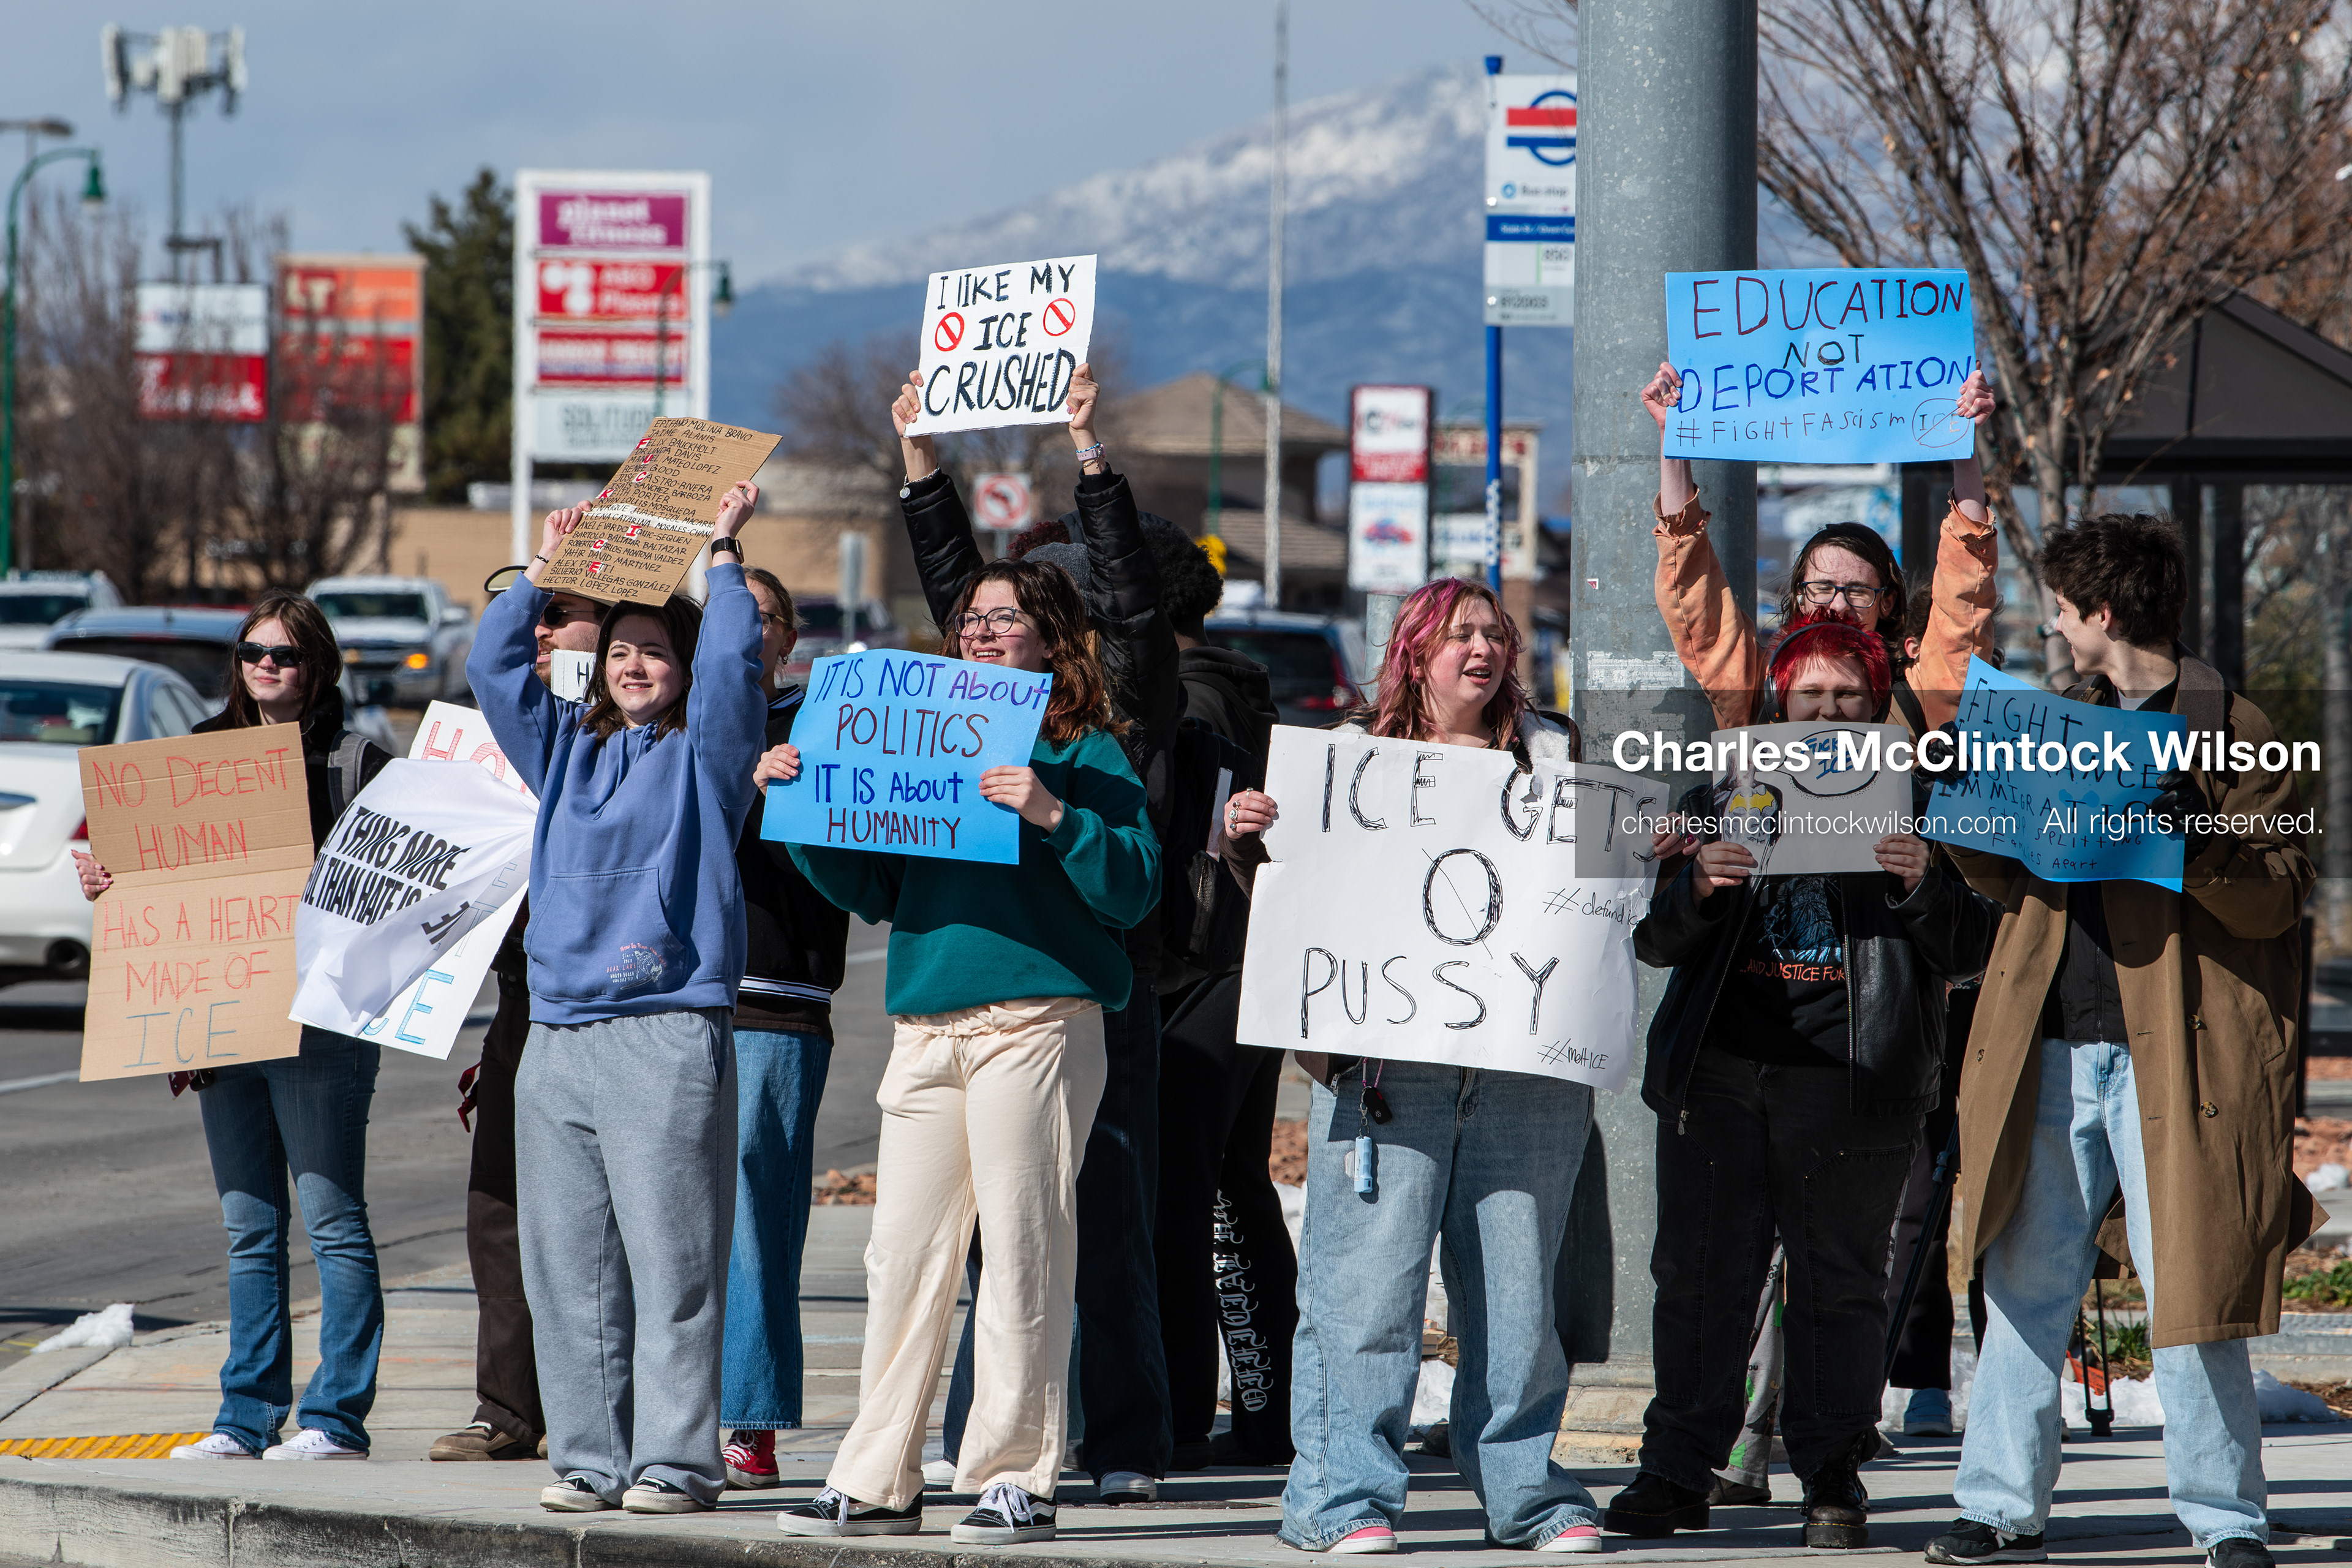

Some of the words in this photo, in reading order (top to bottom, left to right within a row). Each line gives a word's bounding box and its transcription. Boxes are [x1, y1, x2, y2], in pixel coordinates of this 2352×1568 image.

[937, 276, 949, 310] I
[1030, 262, 1076, 295] MY
[1693, 276, 1964, 340] EDUCATION
[973, 312, 1033, 351] ICE
[1783, 334, 1864, 369] NOT
[925, 347, 1076, 417] CRUSHED
[1678, 355, 1972, 414] DEPORTATION
[654, 419, 689, 428] EPIFANO
[688, 420, 723, 434] MOLINA
[725, 428, 753, 441] BRAVO
[681, 429, 715, 443] ALANIS
[635, 437, 668, 449] FELIX
[669, 438, 718, 455] BAUCKHOLT
[674, 448, 701, 461] DAVIS
[622, 464, 647, 473] RENEE
[650, 464, 680, 477] GOOD
[628, 454, 658, 464] MANUEL
[662, 456, 690, 469] MATEO
[691, 461, 722, 475] LOPEZ
[600, 489, 628, 499] KEITH
[631, 489, 670, 503] PORTER
[614, 473, 636, 482] JOSE
[636, 472, 713, 495] CASTRO-RIVERA
[635, 482, 669, 494] SANCHEZ
[671, 489, 710, 502] BARBOZA
[621, 497, 647, 507] LOUIS
[649, 502, 696, 518] MOSQUEDA
[630, 508, 657, 517] JUAN
[681, 517, 715, 528] MACARIO
[578, 521, 595, 530] AXEL
[585, 512, 611, 521] ELENA
[612, 513, 651, 527] CATARINA
[655, 522, 712, 538] MORALES-CHAN
[567, 540, 594, 548] ROBERTO
[593, 540, 622, 554] CARLOS
[623, 548, 652, 560] MONTOYA
[654, 552, 685, 566] VALDEZ
[572, 531, 605, 540] BARTOLO
[607, 534, 641, 548] BALTAZAR
[643, 541, 687, 555] BALTAZAR
[550, 567, 582, 575] SILVERIO
[585, 569, 626, 585] VILLEGAS
[561, 549, 586, 558] YAHIR
[588, 549, 612, 562] DAVID
[613, 557, 662, 573] MARTINEZ
[579, 560, 614, 573] PRETTI
[580, 578, 609, 593] LOPEZ
[611, 587, 639, 597] LOPEZ
[814, 661, 845, 703] IT
[841, 658, 864, 699] IS
[878, 658, 946, 698] NOT
[1967, 677, 2082, 748] FIGHT
[836, 703, 989, 758] POLITICS
[92, 760, 147, 809] NO
[167, 748, 290, 808] DECENT
[816, 764, 841, 803] IT
[853, 767, 875, 804] IS
[889, 771, 963, 804] About
[1322, 744, 1444, 833] ICE
[1499, 767, 1657, 862] GETS
[1939, 778, 2150, 824] IMMIGRATIO
[135, 820, 248, 872] HUMAN
[336, 805, 411, 869] THING
[388, 830, 472, 891] MORE
[315, 856, 366, 918] THAN
[104, 900, 160, 952] HAS
[176, 902, 192, 941] A
[209, 895, 301, 944] HEART
[126, 958, 213, 1005] MADE
[224, 951, 270, 990] OF
[1765, 962, 1819, 981] JUSTICE
[1823, 966, 1845, 981] FOR
[1300, 948, 1560, 1039] PUSSY
[124, 1000, 241, 1068] ICE
